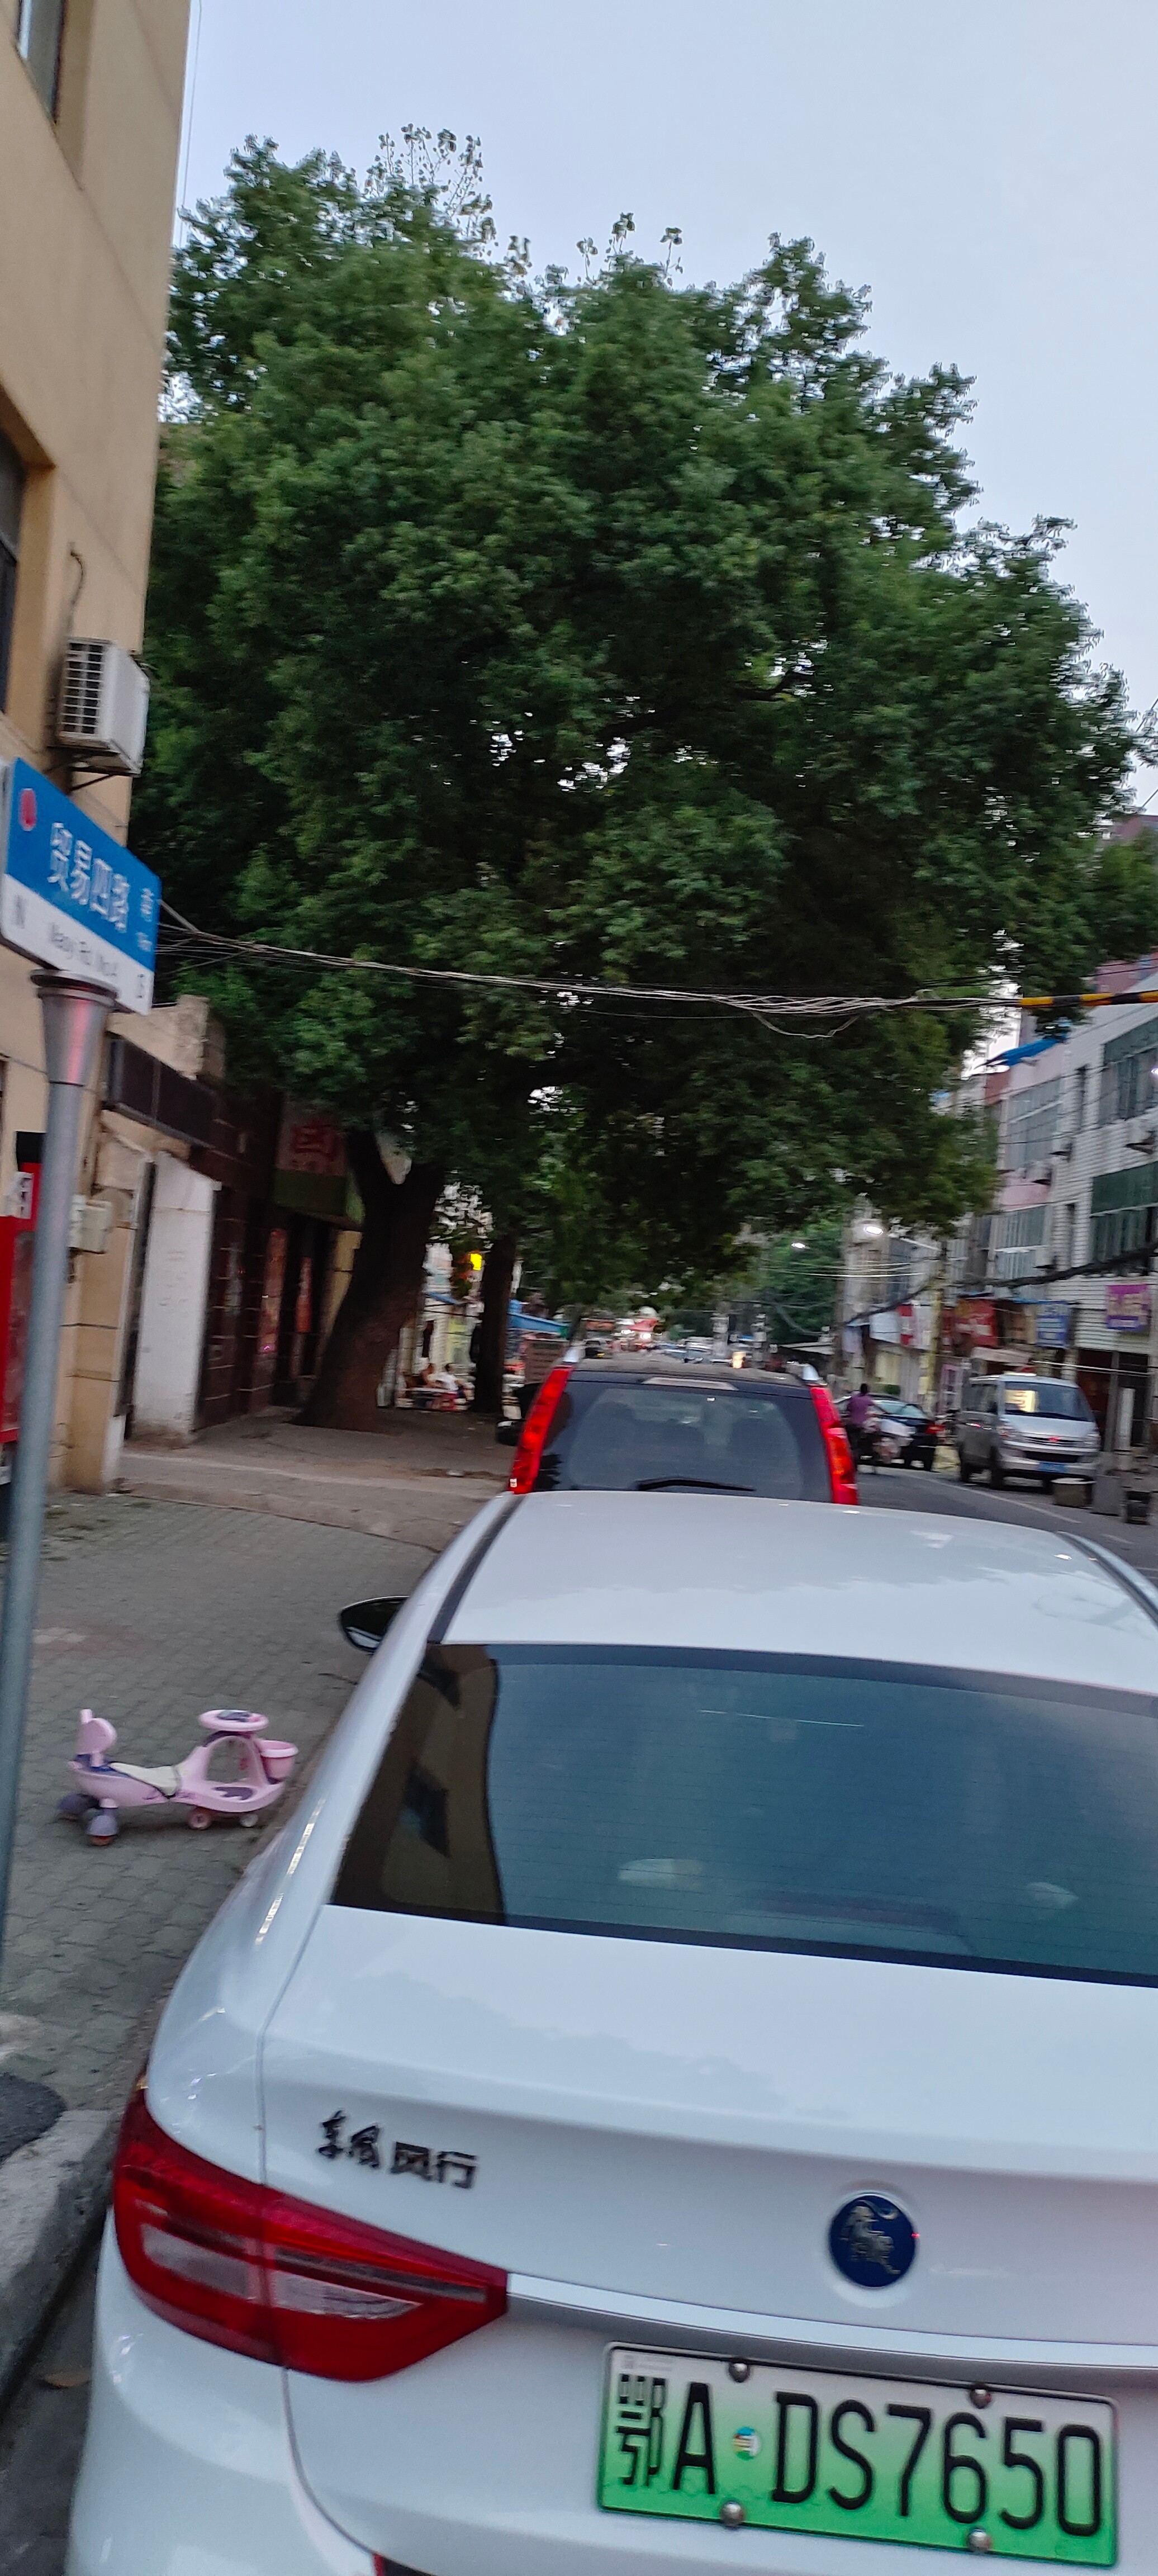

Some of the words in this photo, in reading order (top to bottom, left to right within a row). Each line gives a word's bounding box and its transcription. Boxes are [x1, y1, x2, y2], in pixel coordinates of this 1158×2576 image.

[47, 822, 130, 933] 贸易四路
[771, 2391, 1104, 2539] DS7650
